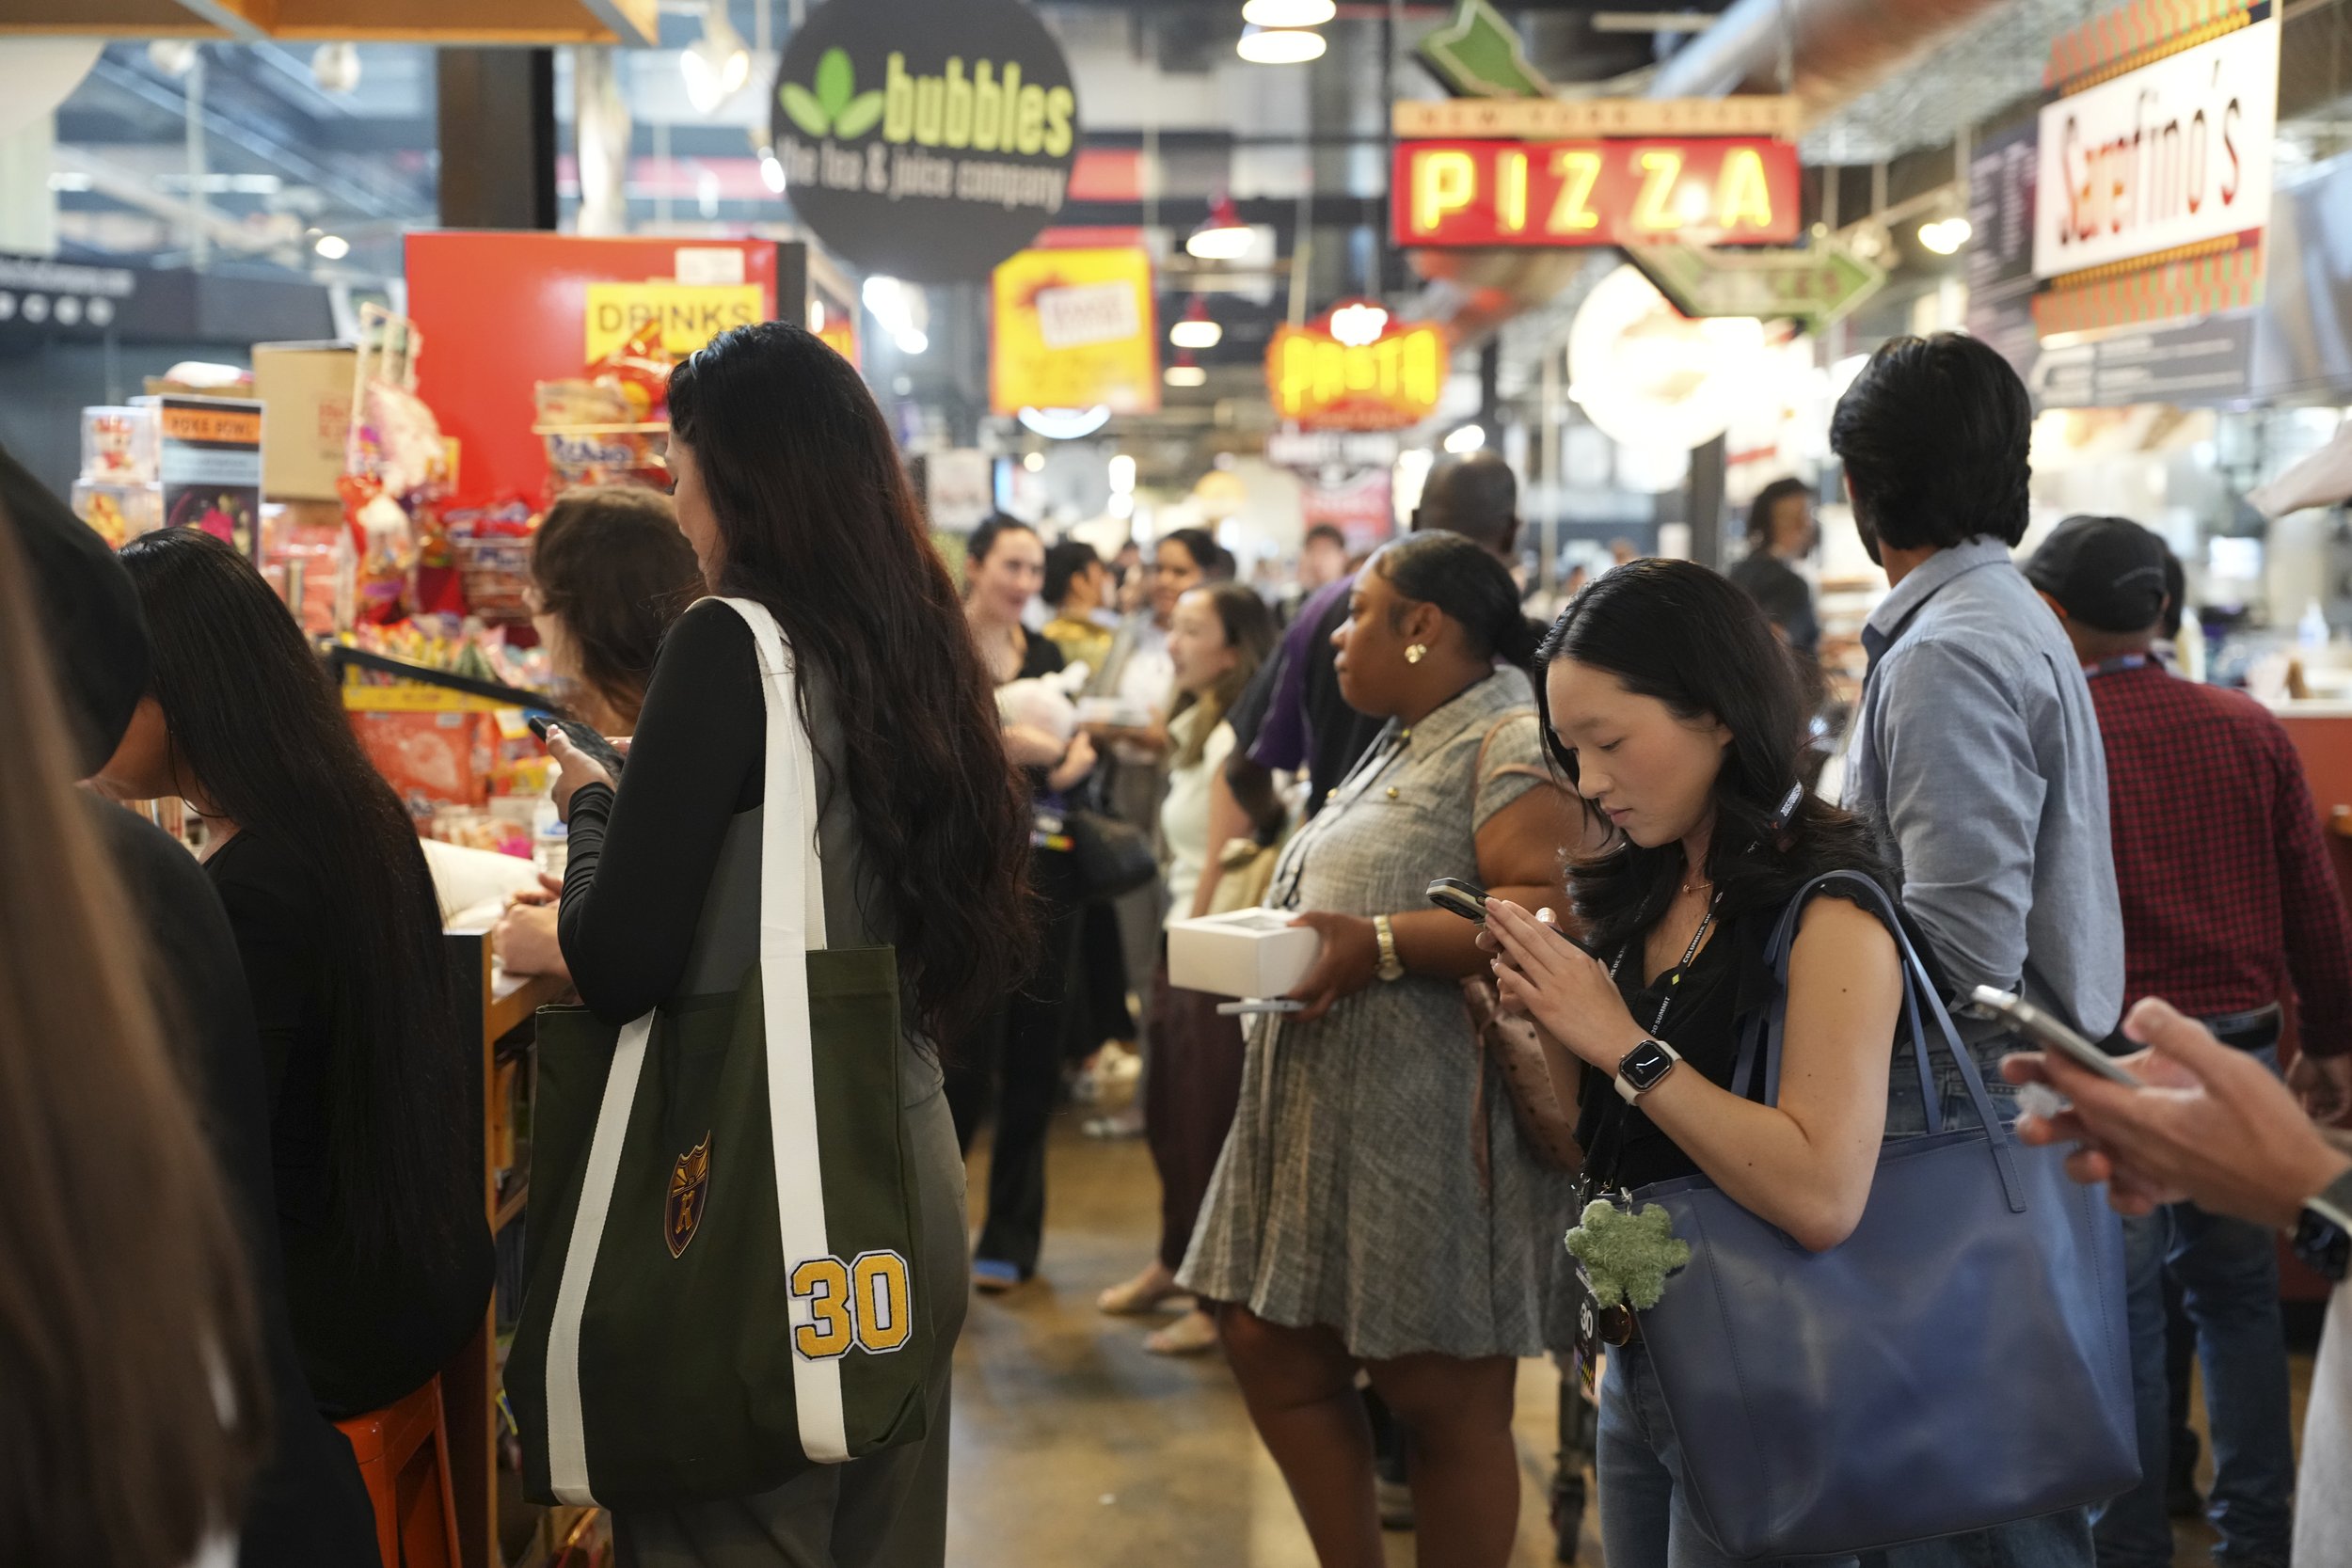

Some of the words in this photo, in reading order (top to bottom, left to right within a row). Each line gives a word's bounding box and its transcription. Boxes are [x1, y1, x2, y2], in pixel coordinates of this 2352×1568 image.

[882, 51, 1074, 158] bubbles
[776, 134, 818, 187] the
[820, 141, 865, 192] tea
[866, 141, 888, 194] &
[887, 145, 954, 202] juice
[956, 158, 1068, 214] company
[1413, 147, 1772, 235] PIZZA
[597, 302, 753, 334] DRINKS
[1279, 329, 1438, 415] PASTA
[1656, 996, 1671, 1024] SUMMIT
[788, 1250, 912, 1360] 30
[1581, 1302, 1594, 1339] 30
